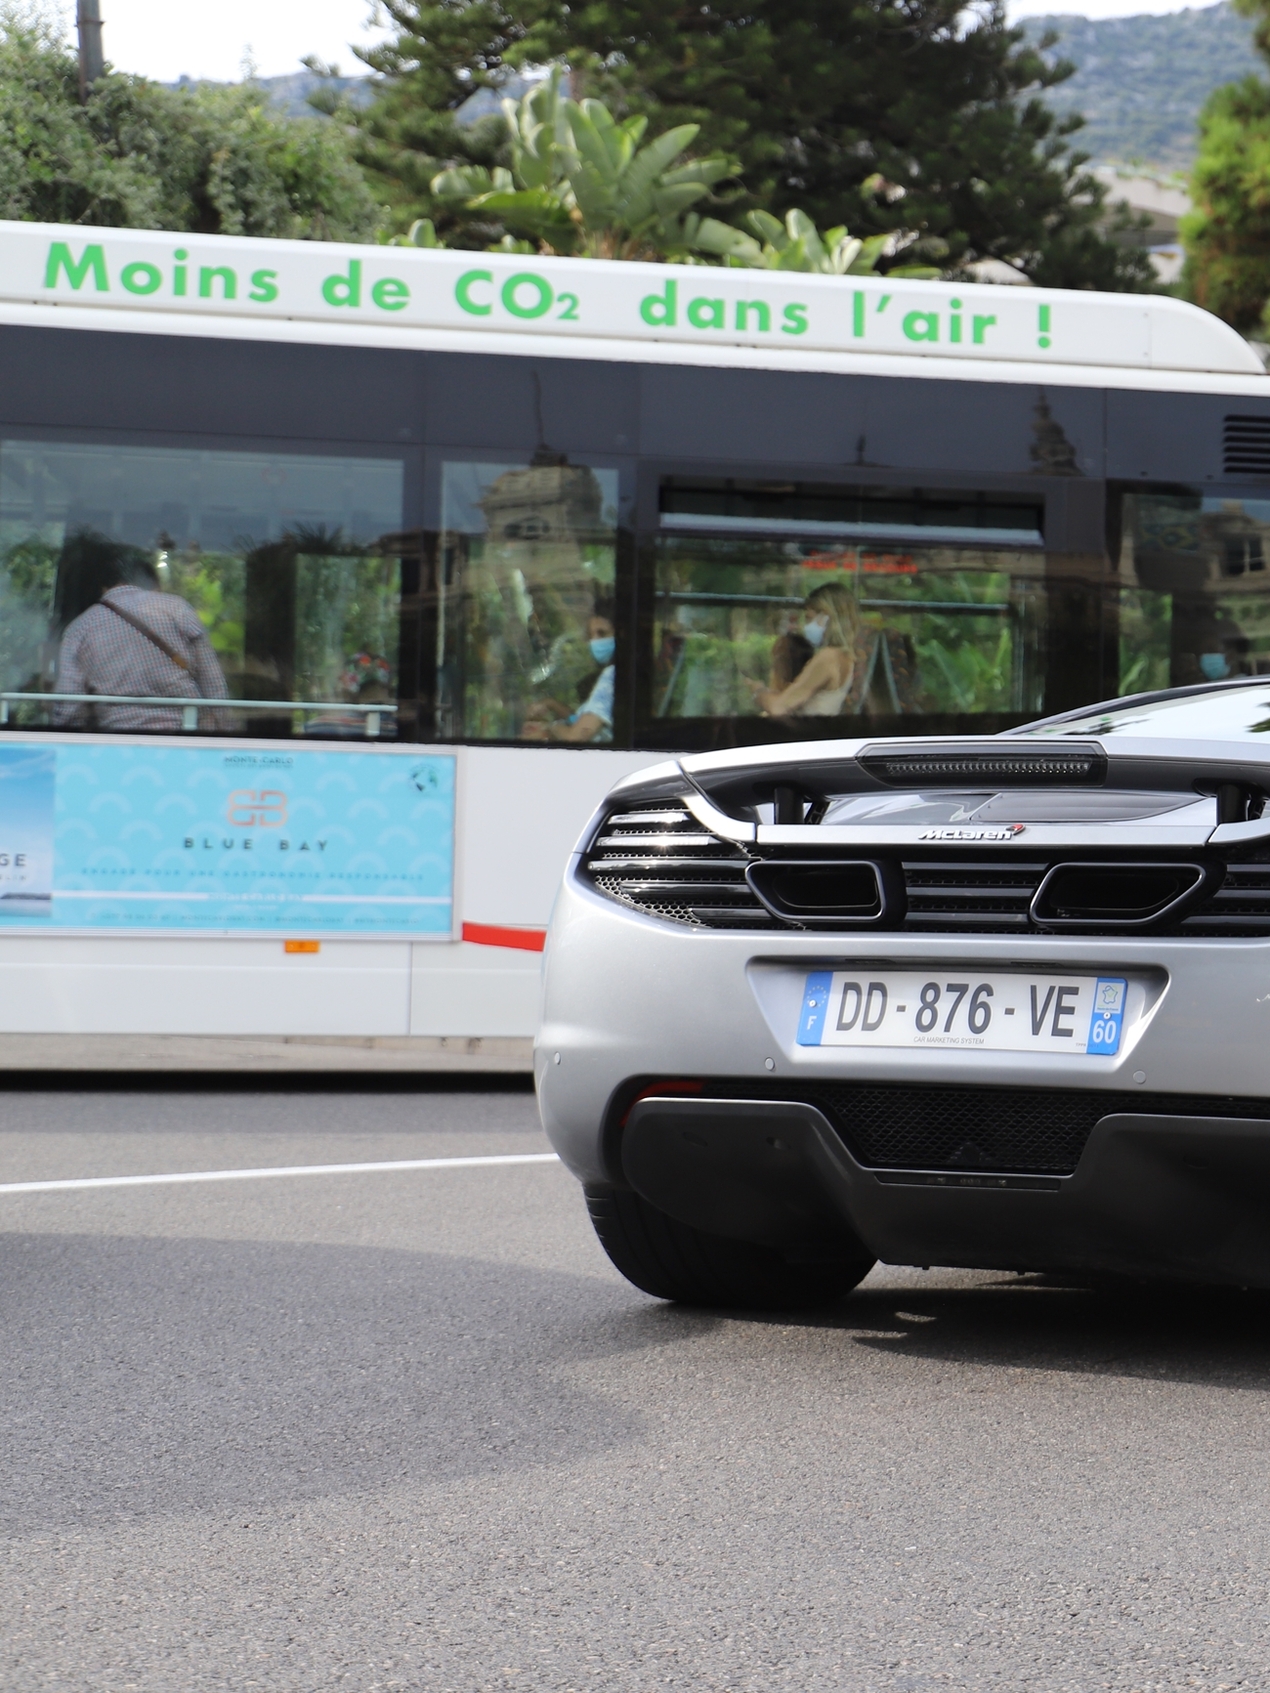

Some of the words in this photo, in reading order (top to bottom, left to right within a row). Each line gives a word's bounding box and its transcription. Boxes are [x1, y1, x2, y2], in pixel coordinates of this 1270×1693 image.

[45, 241, 279, 302] Moins
[321, 259, 411, 311] de
[639, 279, 809, 335] dans
[1037, 304, 1053, 349] !
[917, 829, 1013, 841] McLaren
[184, 837, 253, 850] BLUE
[279, 839, 328, 851] BAY
[806, 1014, 818, 1030] F
[1092, 1019, 1117, 1044] 60
[913, 1035, 926, 1043] CAR
[926, 1036, 960, 1045] MARKETING
[960, 1037, 985, 1045] SYSTEM
